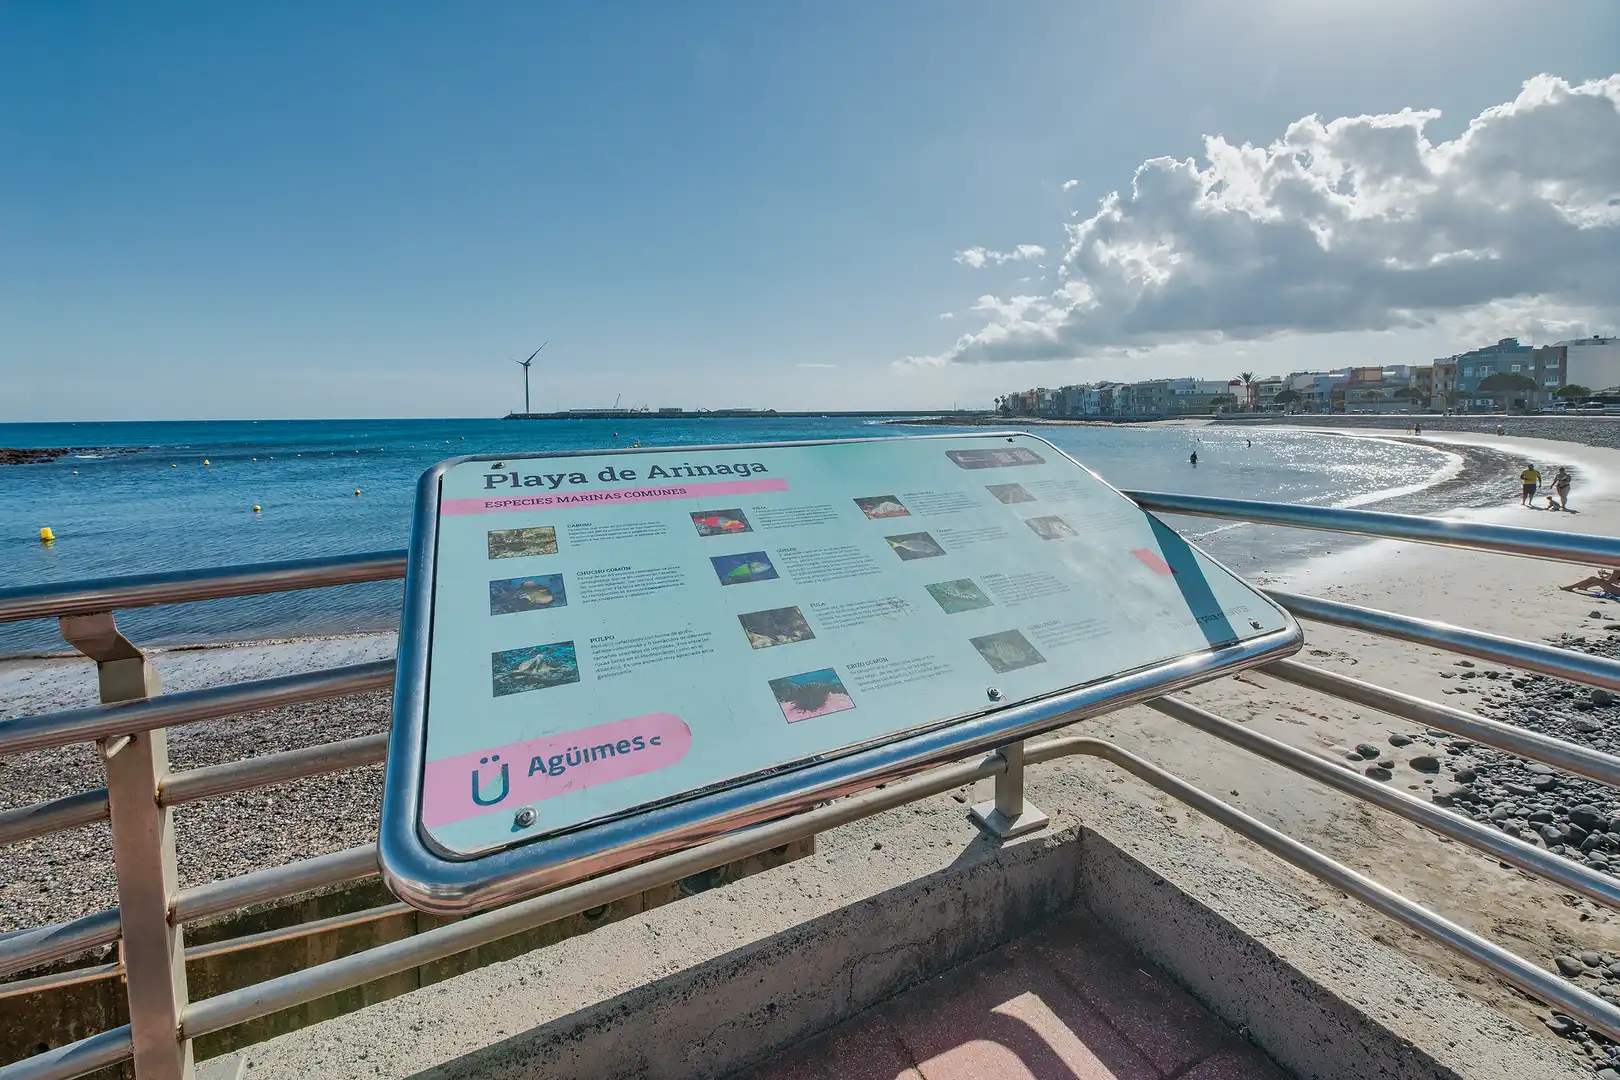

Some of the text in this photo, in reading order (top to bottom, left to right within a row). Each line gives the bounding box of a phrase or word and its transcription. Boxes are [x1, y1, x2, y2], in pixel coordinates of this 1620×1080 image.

[483, 462, 768, 490] Playa de Arinaga
[484, 488, 687, 508] ESPECIES MARINAS COMUNES
[590, 635, 614, 643] PULPO
